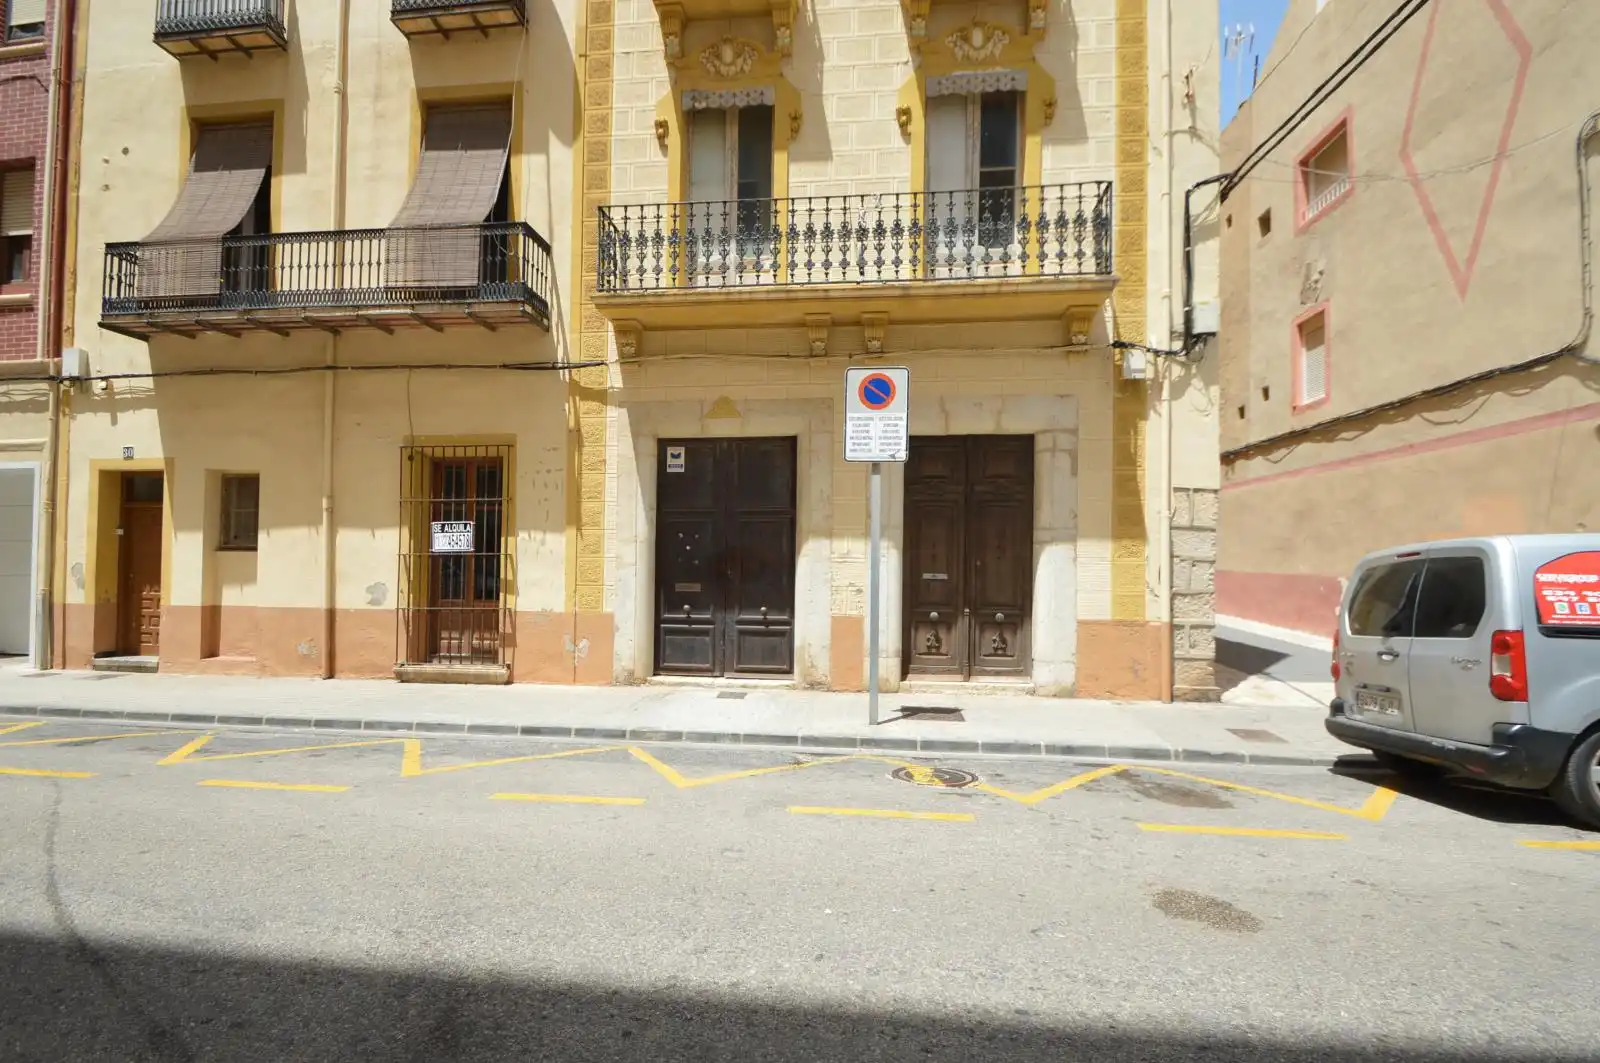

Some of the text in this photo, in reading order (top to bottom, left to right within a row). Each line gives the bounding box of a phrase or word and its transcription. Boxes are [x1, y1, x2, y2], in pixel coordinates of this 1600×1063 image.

[123, 447, 133, 457] 30
[433, 523, 470, 532] SE ALQUILA
